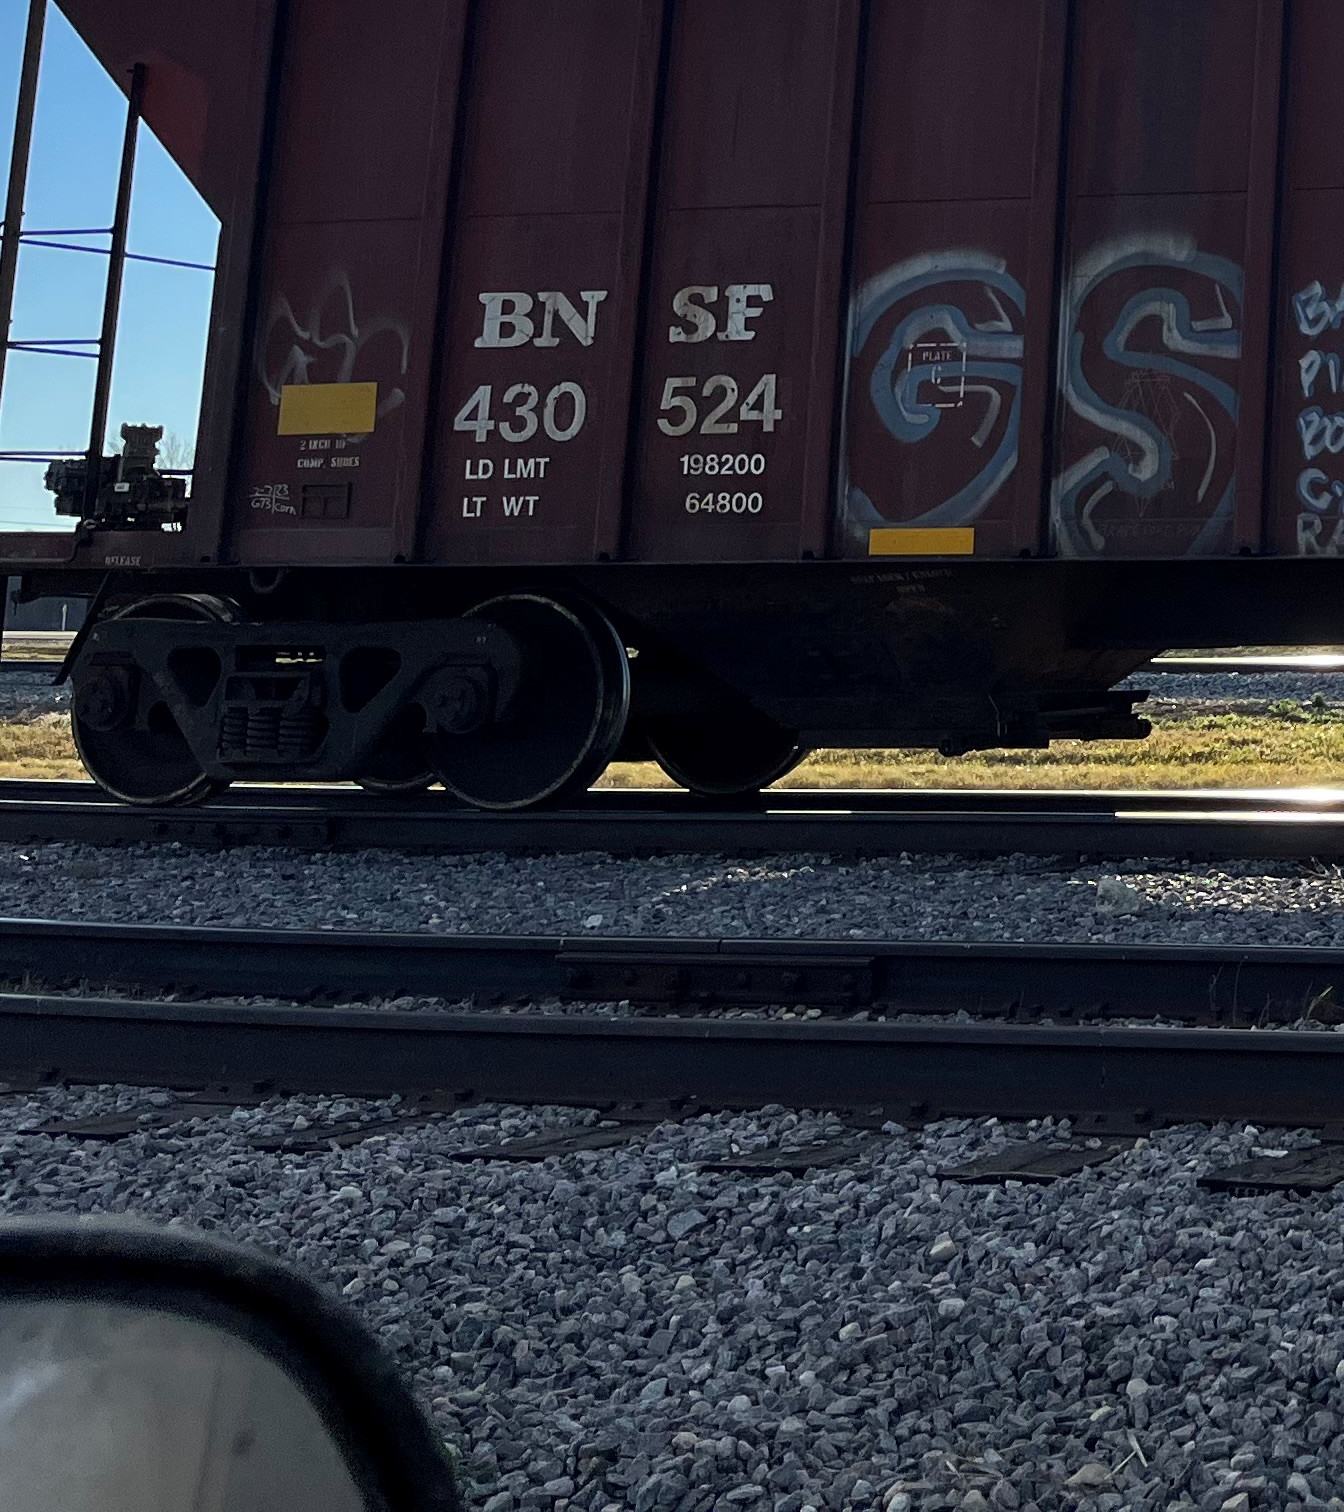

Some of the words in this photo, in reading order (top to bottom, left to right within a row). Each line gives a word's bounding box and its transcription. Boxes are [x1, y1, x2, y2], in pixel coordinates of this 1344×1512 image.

[473, 289, 609, 349] BN
[668, 283, 774, 344] SF
[922, 350, 954, 362] PLATE
[453, 381, 587, 443] 430
[656, 373, 783, 437] 524
[465, 458, 494, 480] LD
[503, 457, 550, 480] LMT
[679, 452, 767, 476] 198200
[461, 496, 487, 518] LT
[502, 495, 540, 517] WT
[684, 491, 764, 515] 64800
